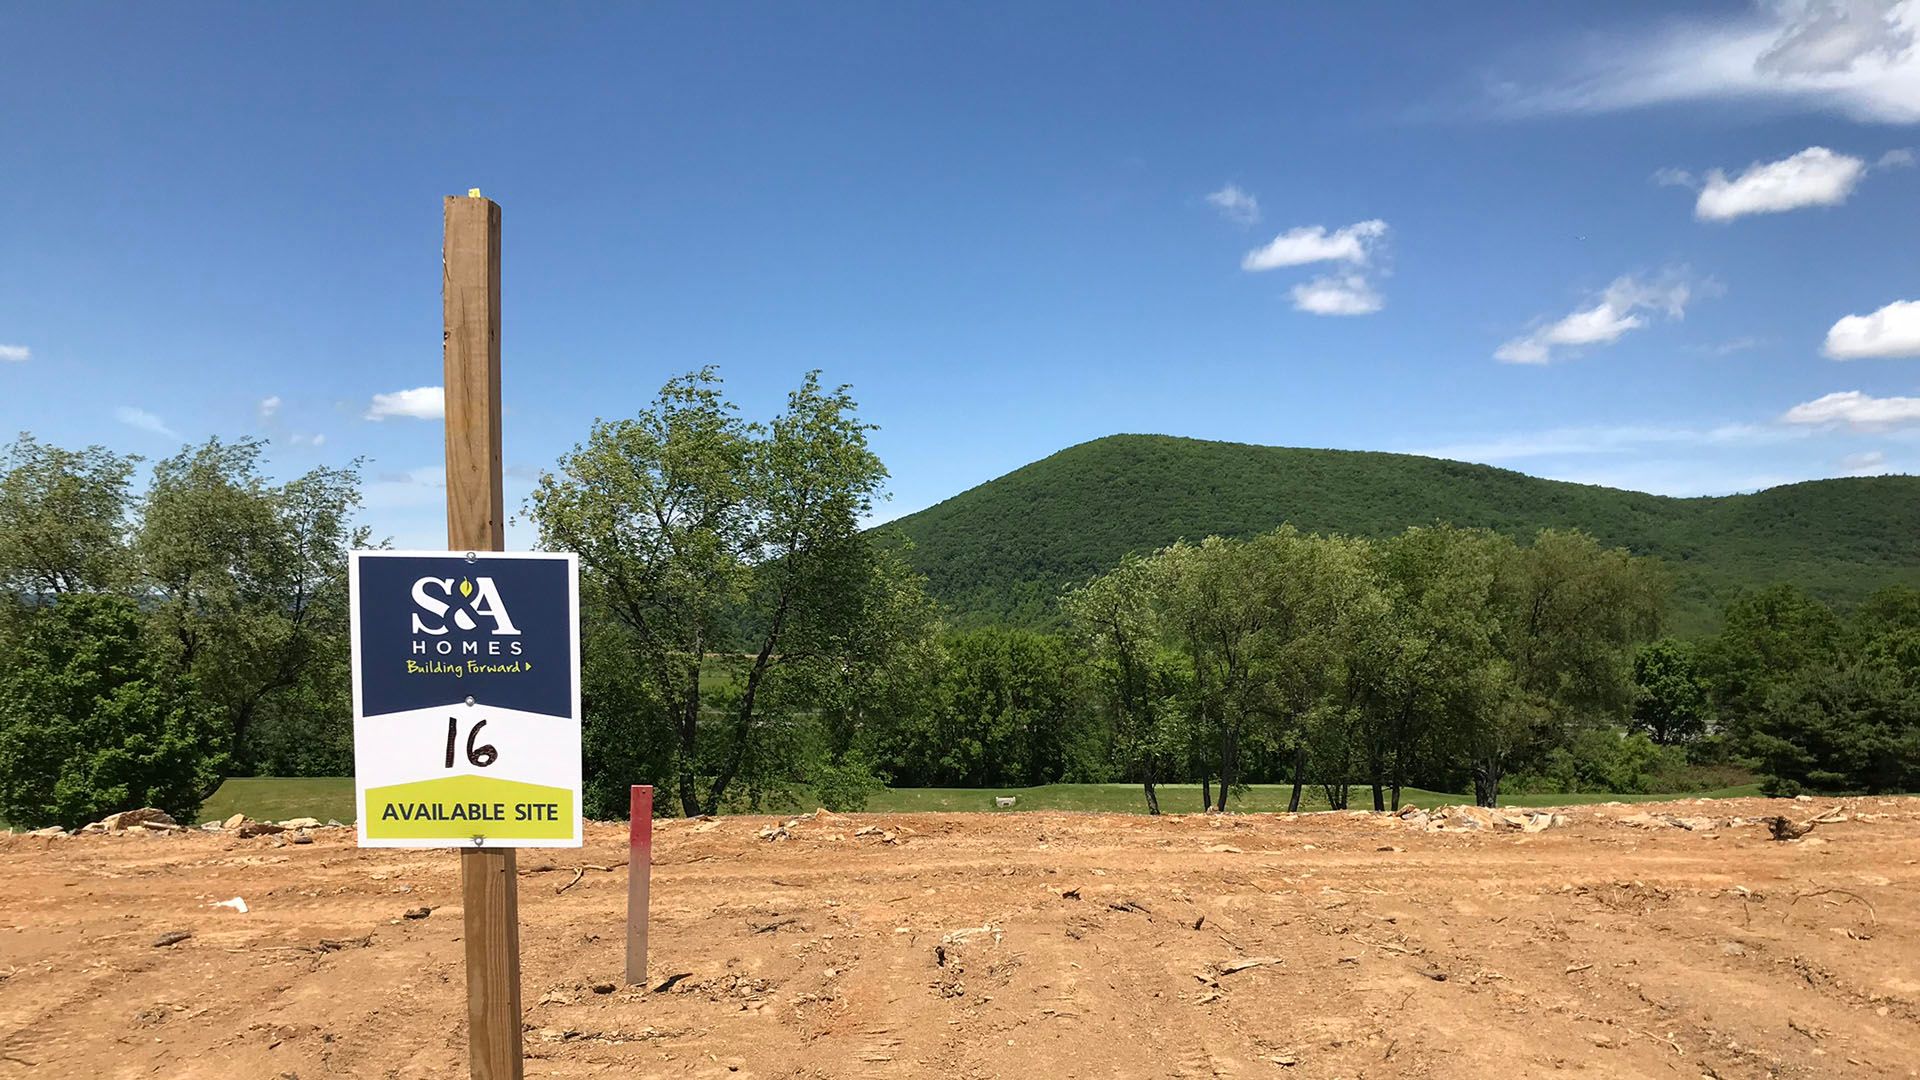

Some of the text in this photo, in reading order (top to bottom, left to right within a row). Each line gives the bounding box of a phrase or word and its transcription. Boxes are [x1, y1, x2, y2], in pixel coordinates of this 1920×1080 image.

[411, 576, 522, 635] S&A
[412, 640, 523, 656] HOMES
[406, 660, 521, 678] Building Forward
[445, 716, 498, 769] 16
[381, 803, 559, 821] AVAILABLE SITE
